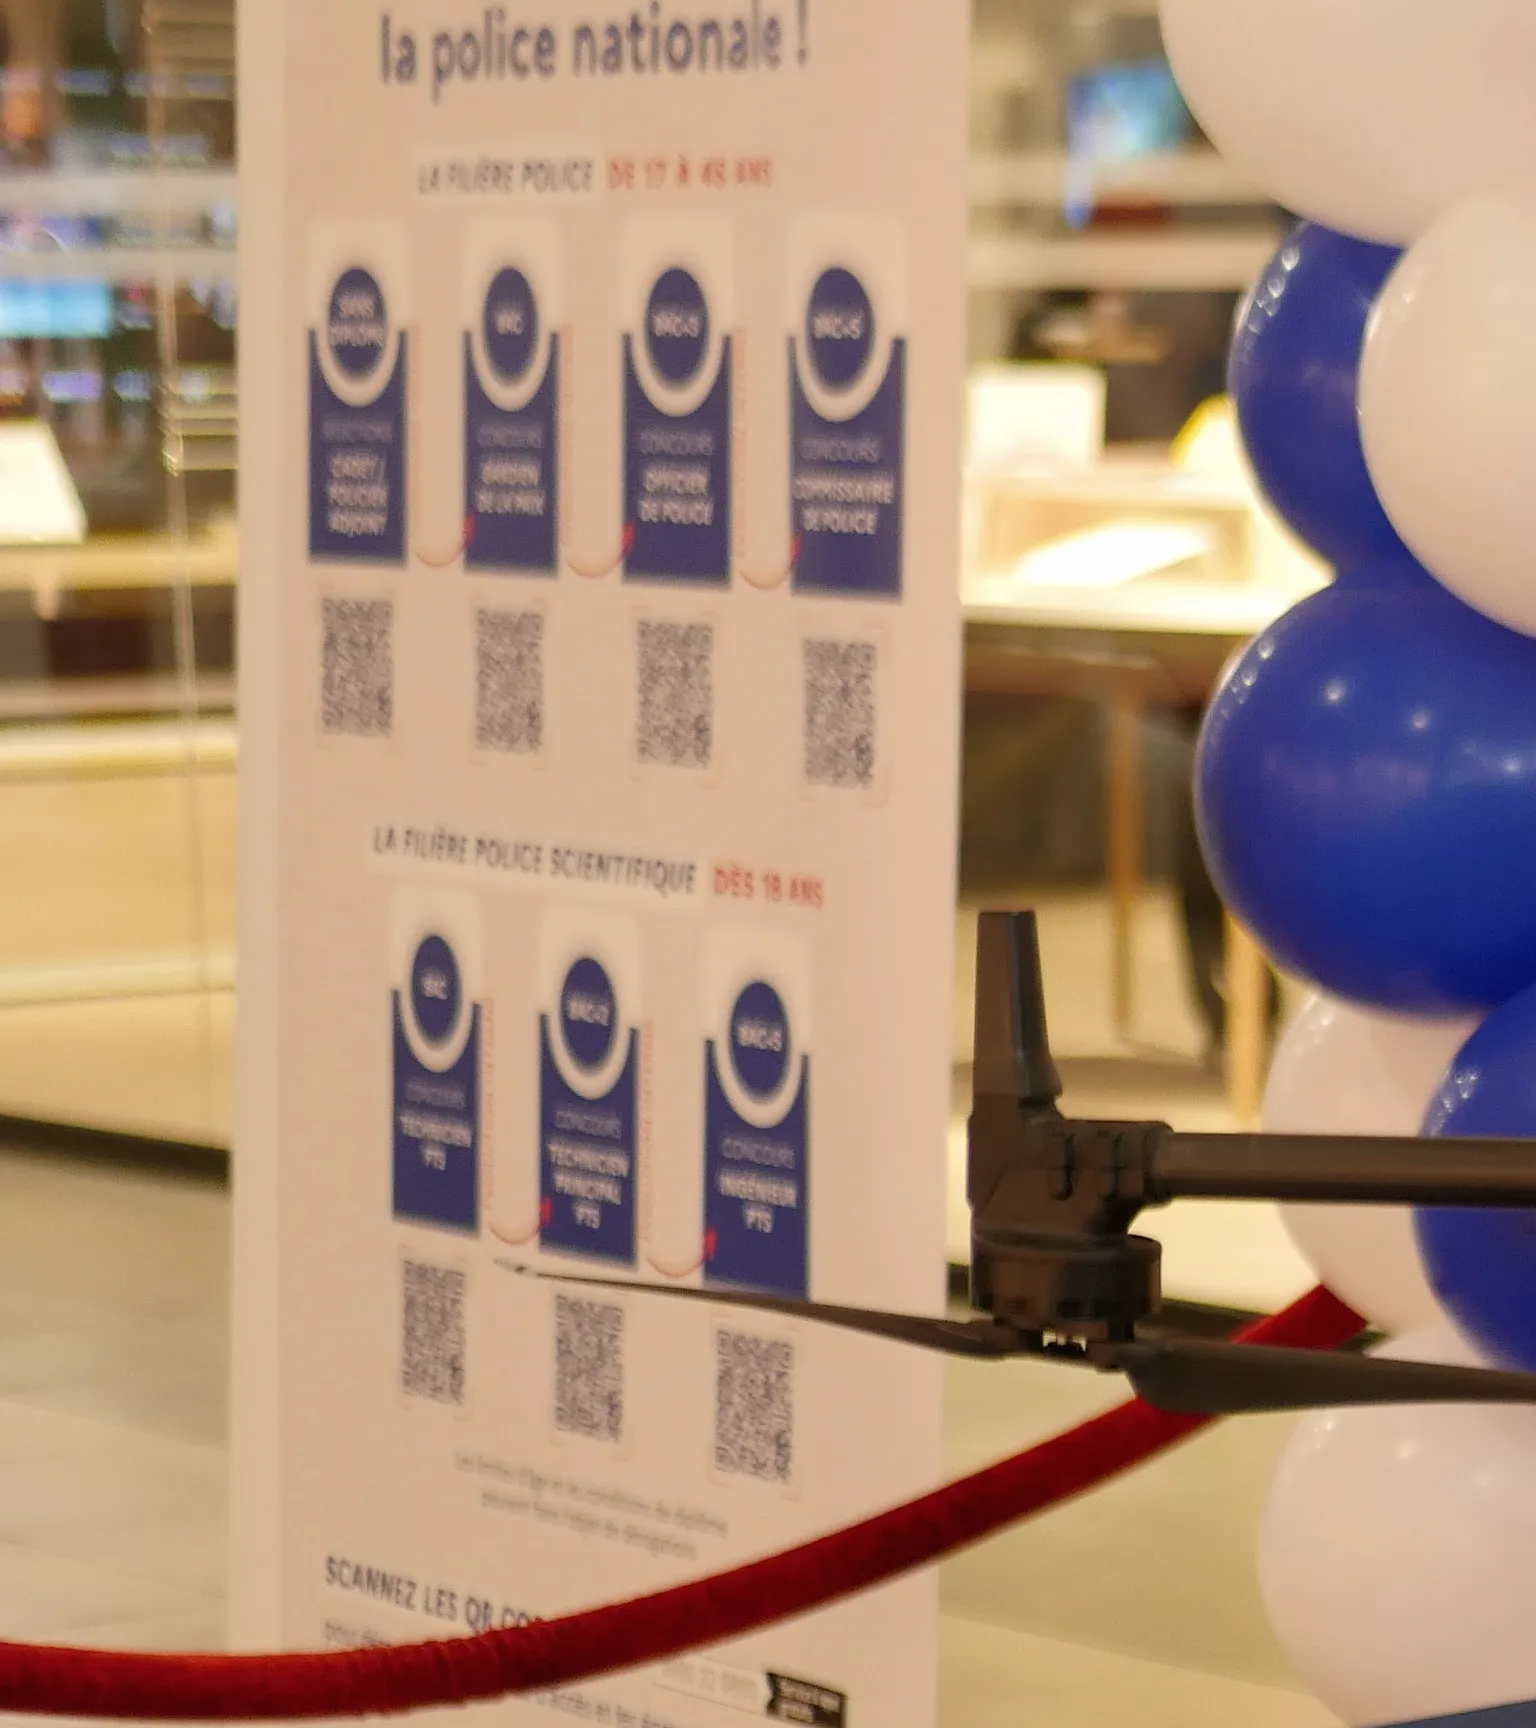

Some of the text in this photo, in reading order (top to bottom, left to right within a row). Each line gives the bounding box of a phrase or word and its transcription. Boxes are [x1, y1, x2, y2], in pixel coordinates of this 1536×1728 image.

[379, 12, 418, 86] la
[431, 7, 557, 106] police
[571, 0, 782, 77] nationale
[419, 160, 440, 193] LA
[521, 159, 594, 192] POLICE
[608, 158, 635, 189] DE
[373, 824, 397, 854] LA
[403, 826, 468, 864] FILIÈRE
[475, 836, 543, 875] POLICE
[550, 846, 697, 898] SCIENTIFIQUE
[325, 1554, 416, 1611] SCANNEZ
[424, 1586, 457, 1622] LES
[465, 1595, 493, 1635] QR
